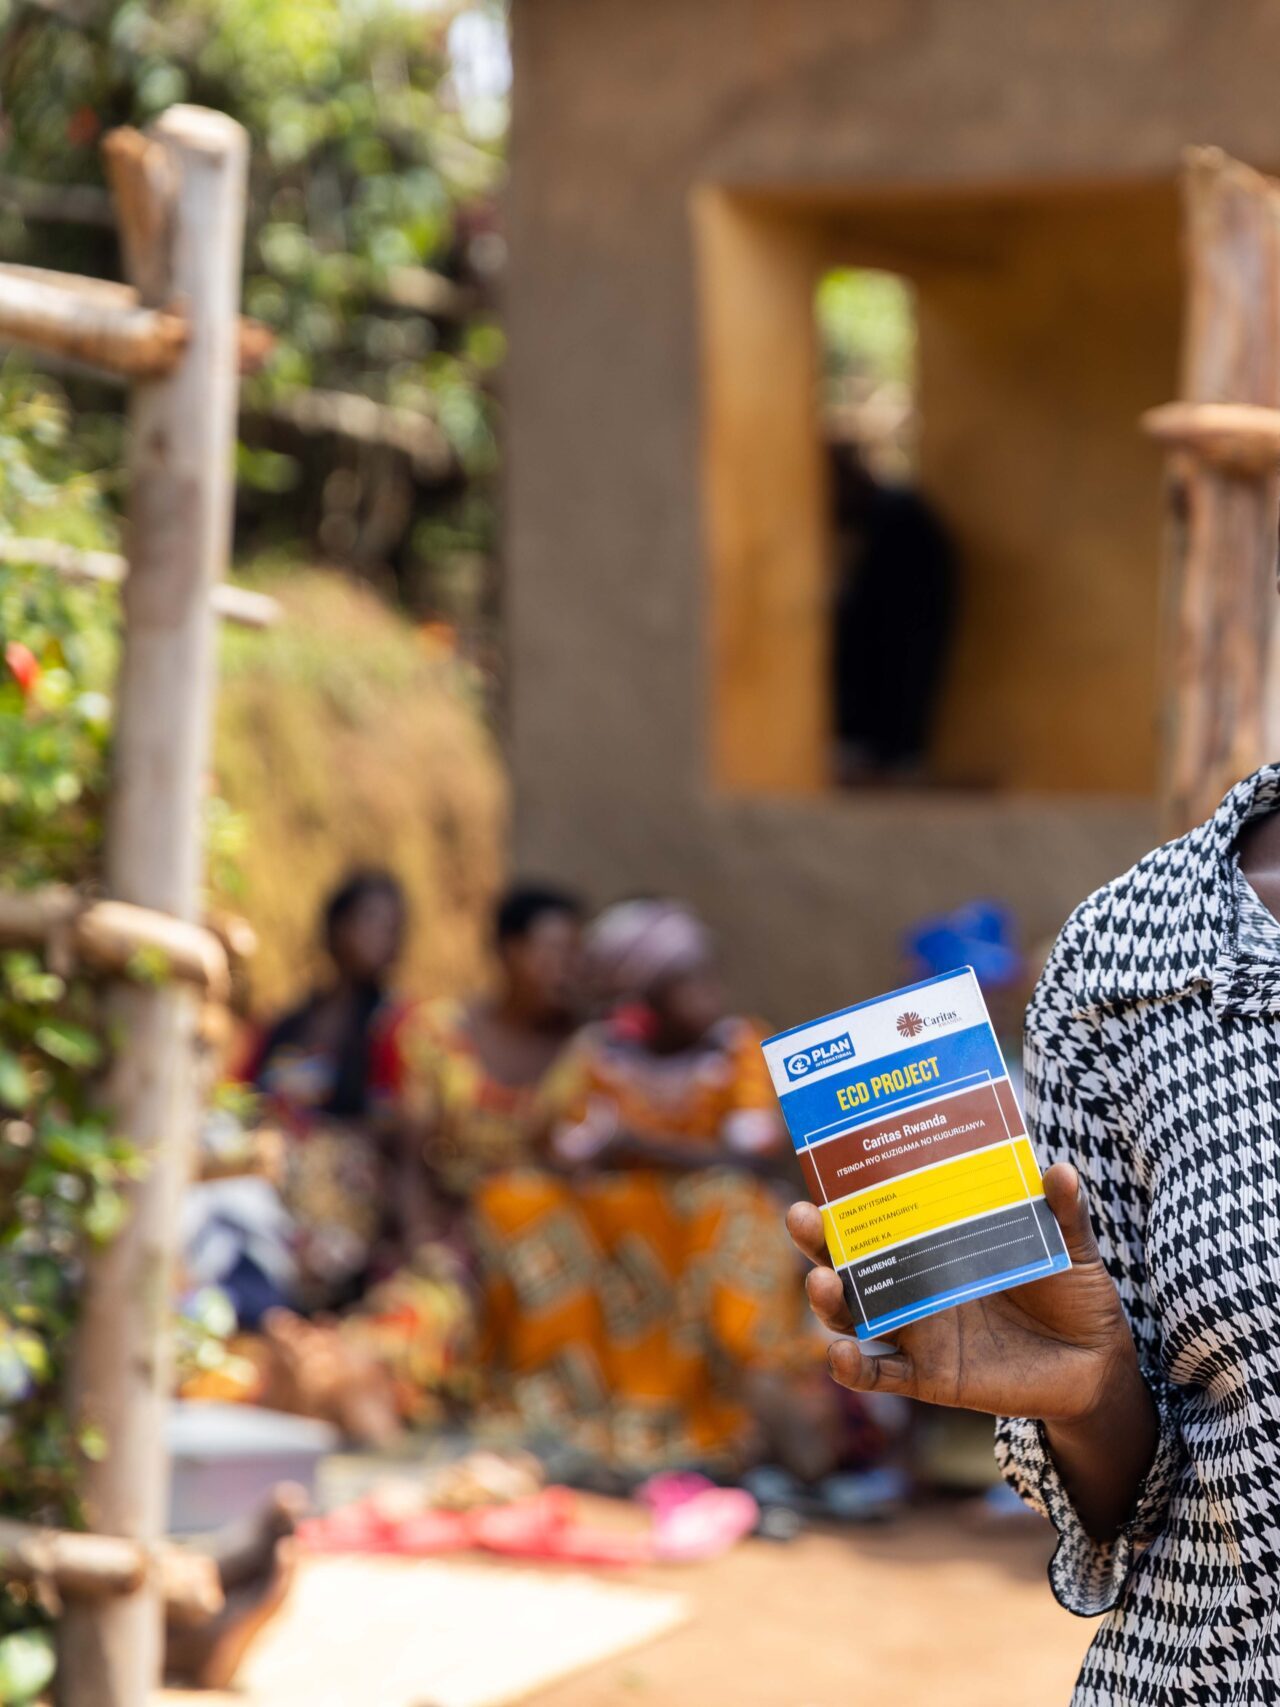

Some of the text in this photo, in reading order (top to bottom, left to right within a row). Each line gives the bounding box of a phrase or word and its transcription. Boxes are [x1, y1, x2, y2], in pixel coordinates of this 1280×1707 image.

[923, 1011, 957, 1027] Caritas
[811, 1038, 851, 1062] PLAN
[815, 1052, 852, 1067] INTERNATIONAL
[836, 1056, 940, 1111] ECD PROJECT
[862, 1113, 947, 1151] Caritas Rwanda
[836, 1120, 986, 1177] ITSINDA RYO KUZIGAMA NO KUGURIZANYA
[838, 1209, 857, 1220] IZINA
[844, 1203, 919, 1237] ITARIKI RYATANGIRIYE
[850, 1231, 892, 1253] AKARERE KA
[857, 1256, 897, 1278] UMURENGE
[864, 1278, 894, 1296] AKAGARI
